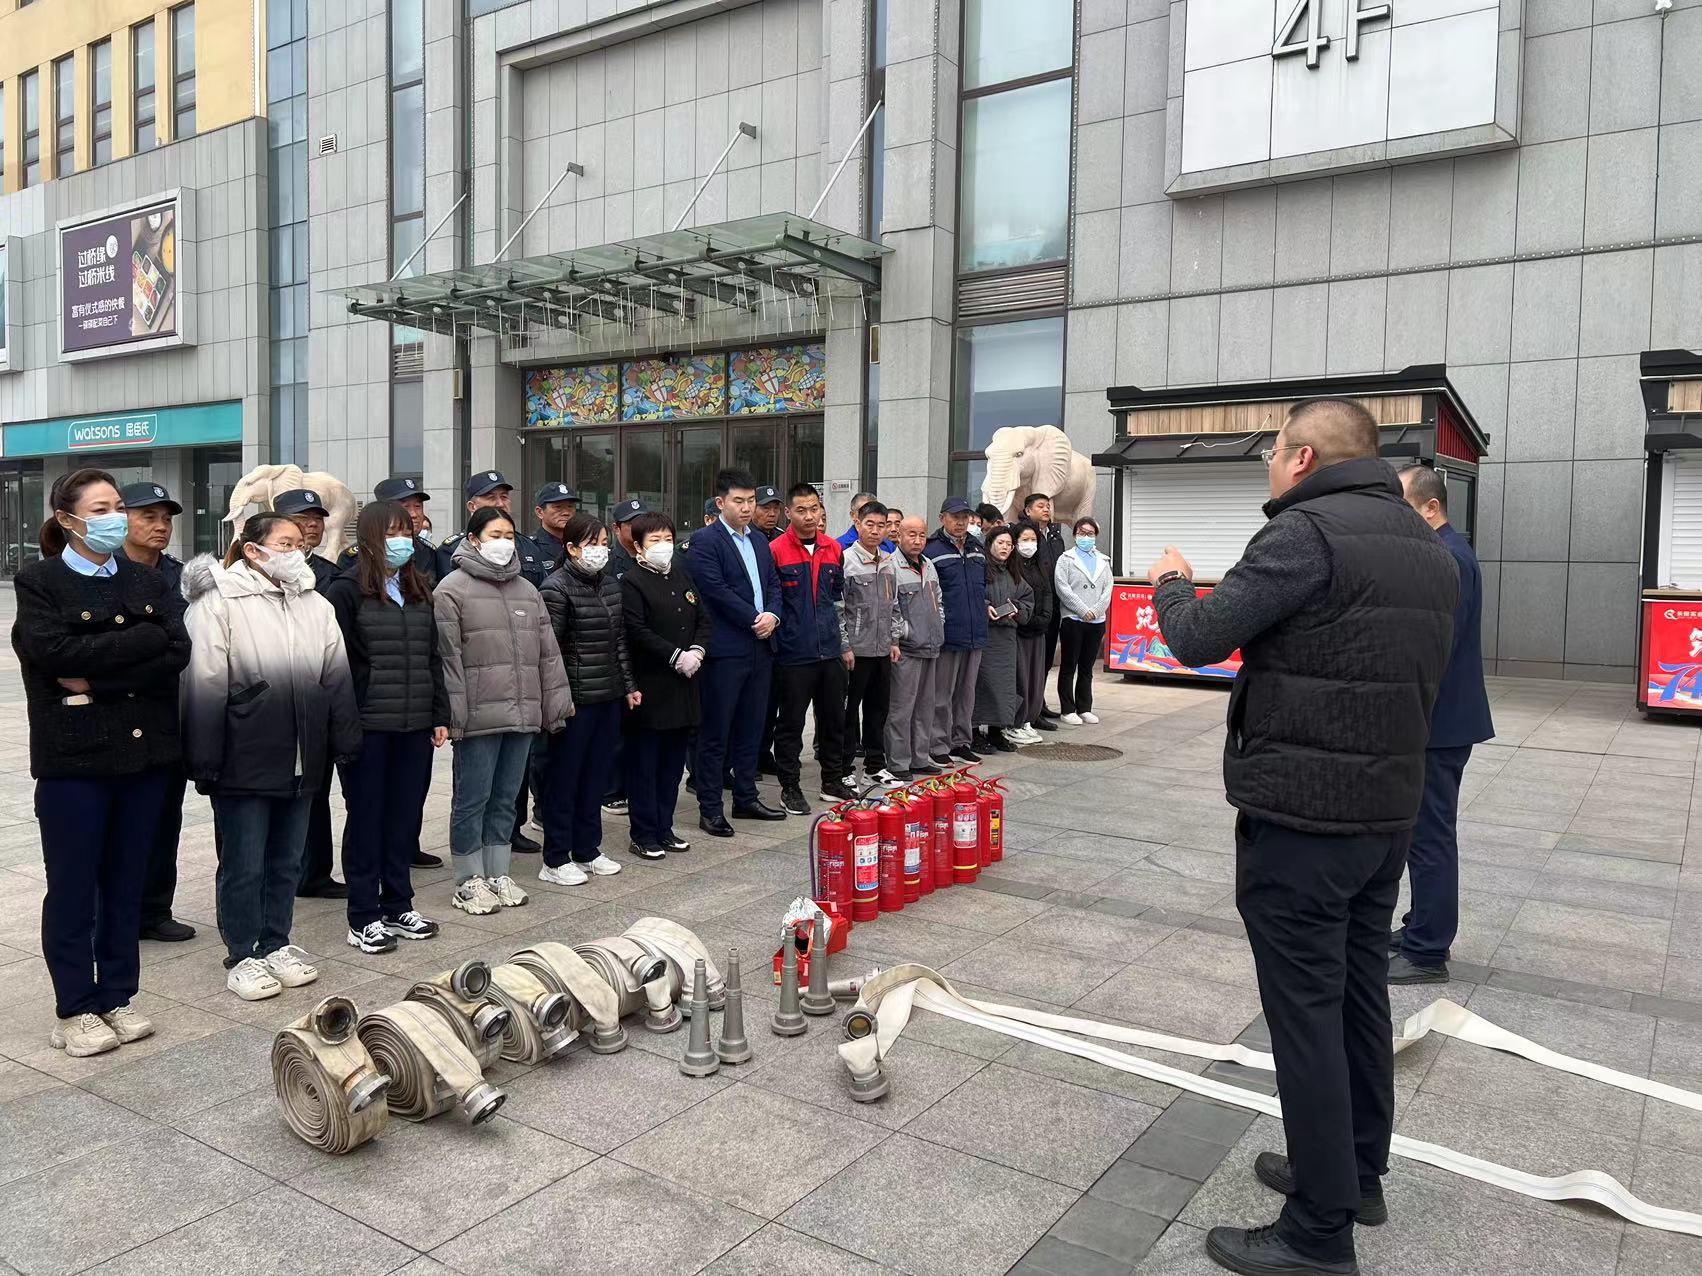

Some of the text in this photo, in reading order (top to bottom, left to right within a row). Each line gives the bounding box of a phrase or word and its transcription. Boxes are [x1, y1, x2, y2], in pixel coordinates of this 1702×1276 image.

[78, 265, 116, 288] 过桥米线
[74, 421, 150, 441] watsons 屈臣氏
